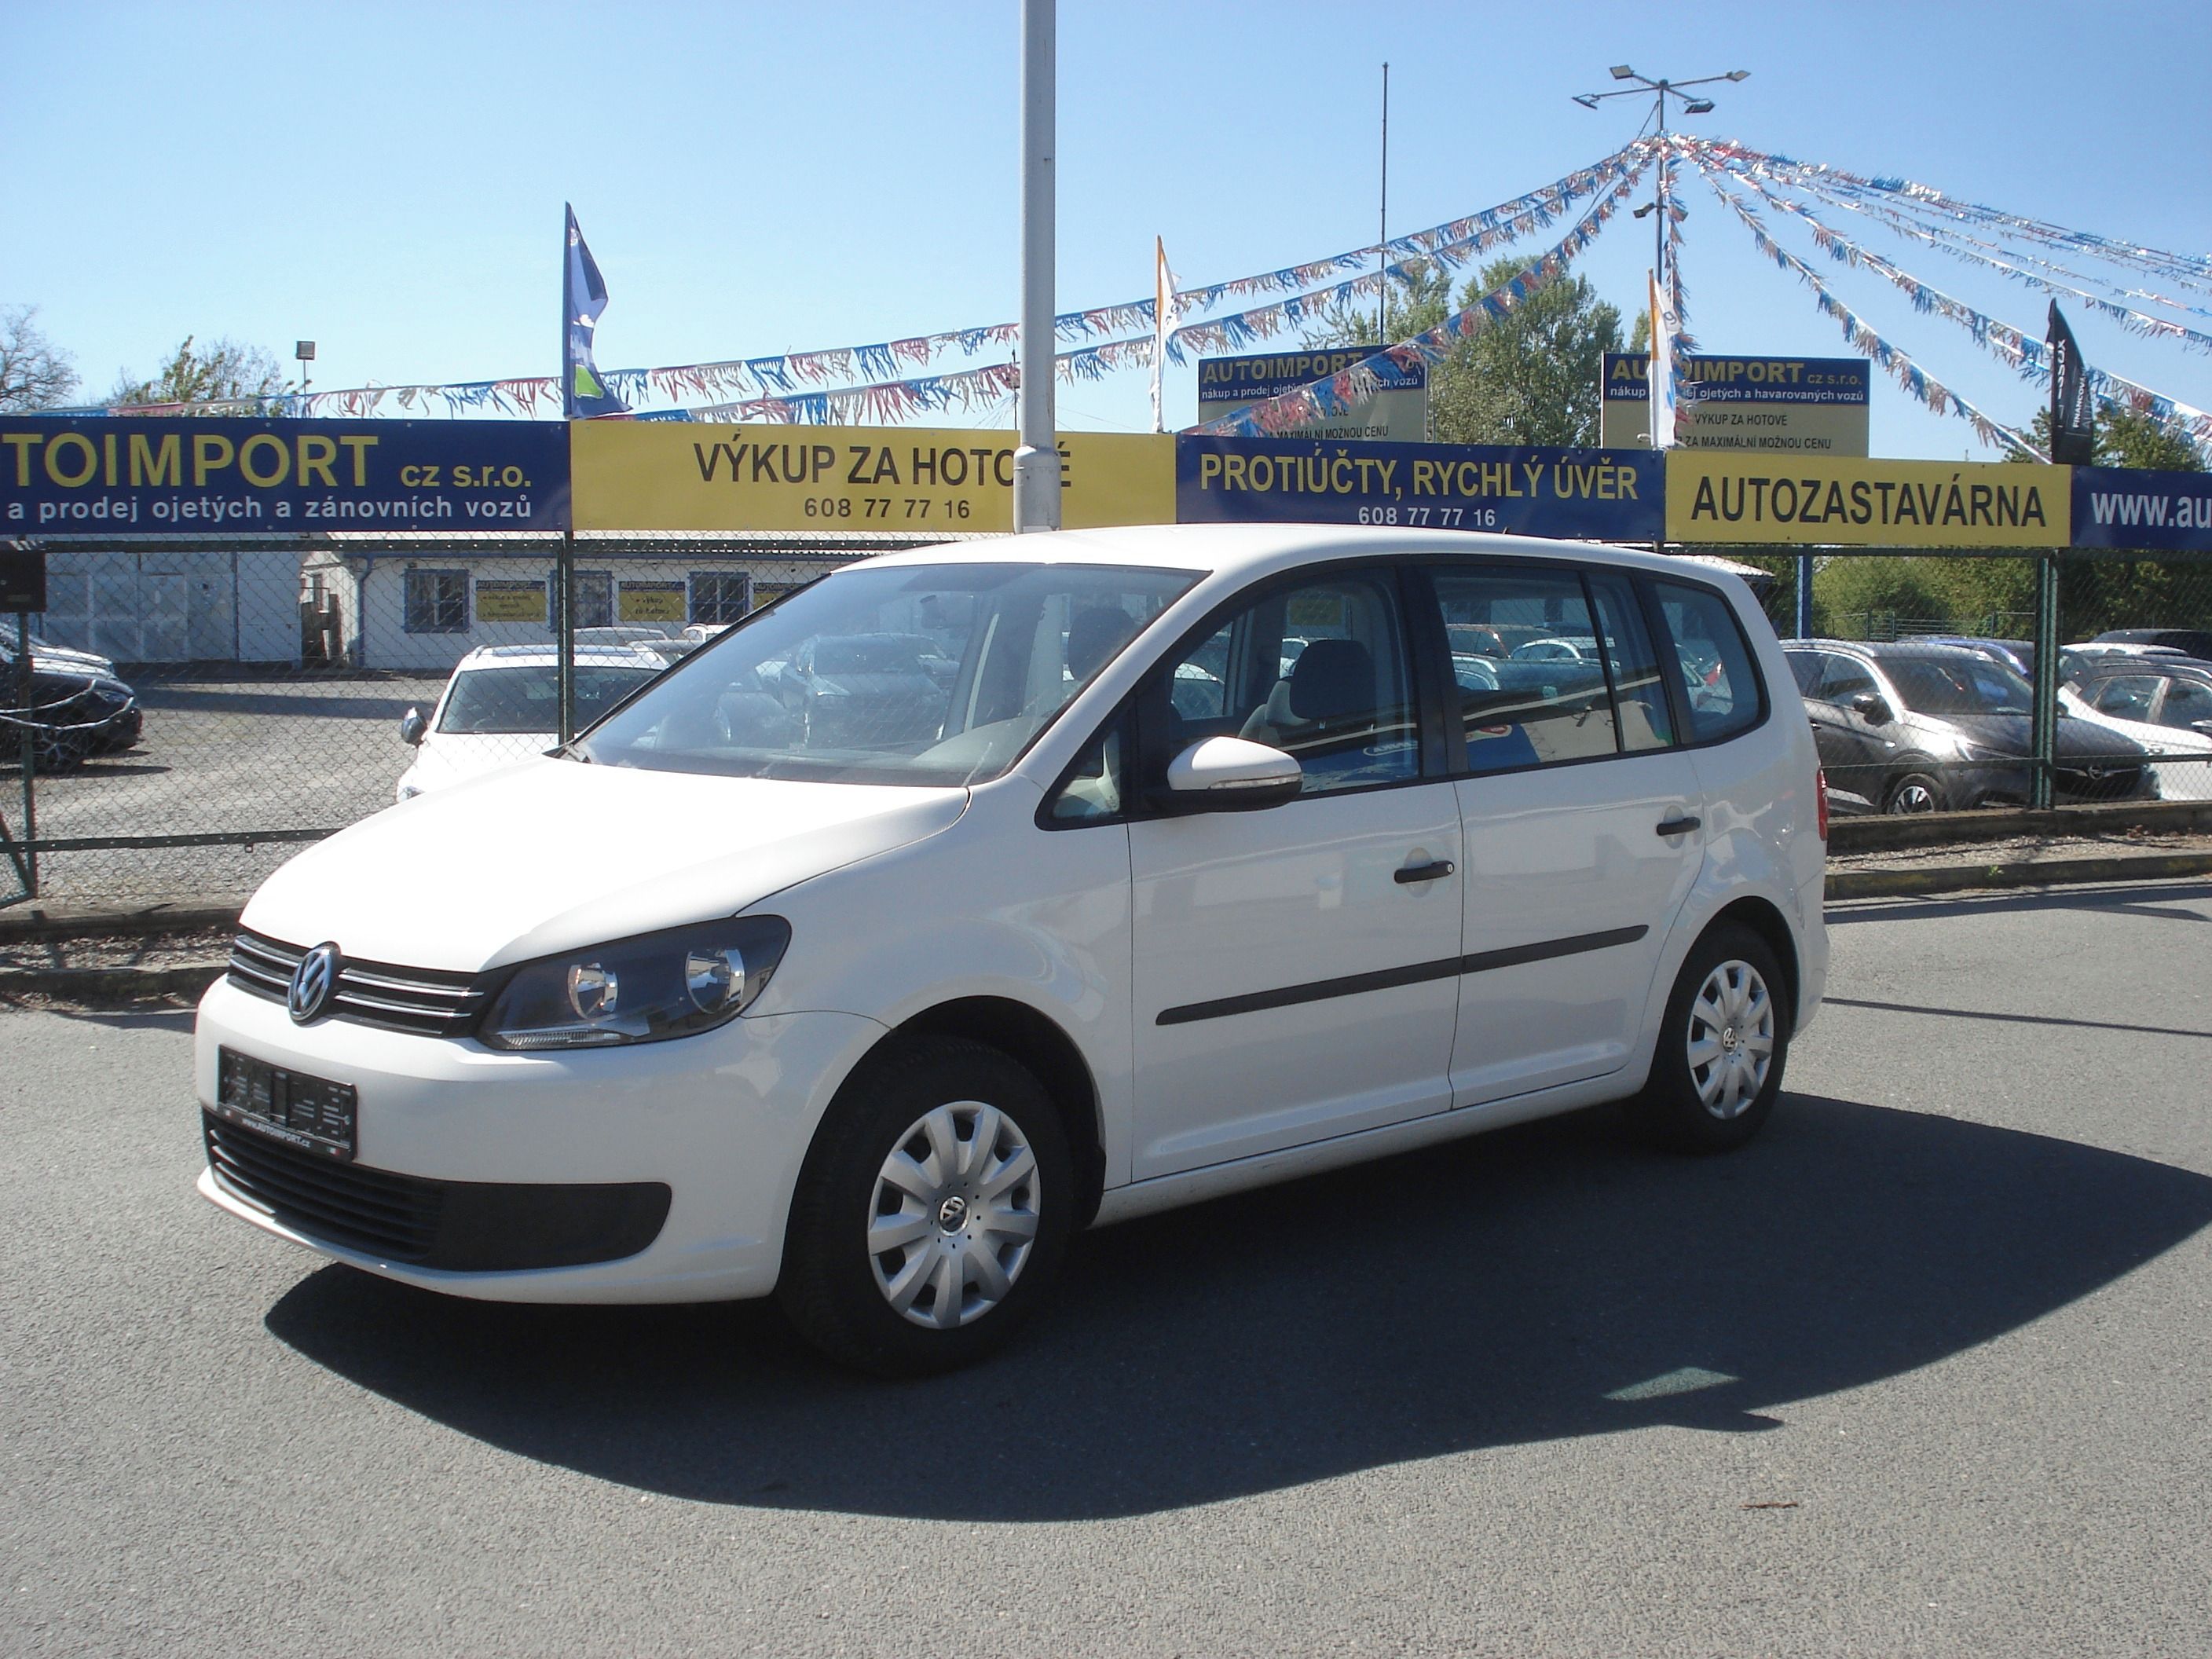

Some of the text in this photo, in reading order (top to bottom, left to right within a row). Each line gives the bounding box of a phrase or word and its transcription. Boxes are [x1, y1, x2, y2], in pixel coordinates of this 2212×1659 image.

[1612, 359, 1862, 385] AUIMPORT cz s.r.o.
[1202, 386, 1230, 399] nákup
[1241, 385, 1270, 399] prodej
[1610, 386, 1646, 399] nákup
[1700, 388, 1741, 400] ojetých
[1755, 389, 1835, 401] havarovaných
[1695, 412, 1728, 426] VÝKUP
[1730, 415, 1744, 426] ZA
[1326, 426, 1363, 439] MOŽNOU
[1364, 426, 1389, 438] CENU
[1686, 436, 1698, 447] ZA
[1701, 435, 1756, 449] MAXIMÁLNÍ
[1760, 435, 1801, 449] MOŽNOU
[1805, 438, 1831, 449] CENU
[2, 433, 532, 488] TOIMPORT cz s.r.o.
[694, 434, 1071, 487] VÝKUP ZA HOTOÉ
[1201, 449, 1639, 501] PROTIÚČTY, RYCHLÝ ÚVĚR
[8, 494, 531, 523] a prodej ojetých a zánovních vozů
[804, 498, 970, 518] 608 77 77 16
[1691, 473, 2046, 527] AUTOZASTAVÁRNA
[1358, 507, 1496, 526] 608 77 77 16
[2091, 493, 2212, 529] www.au
